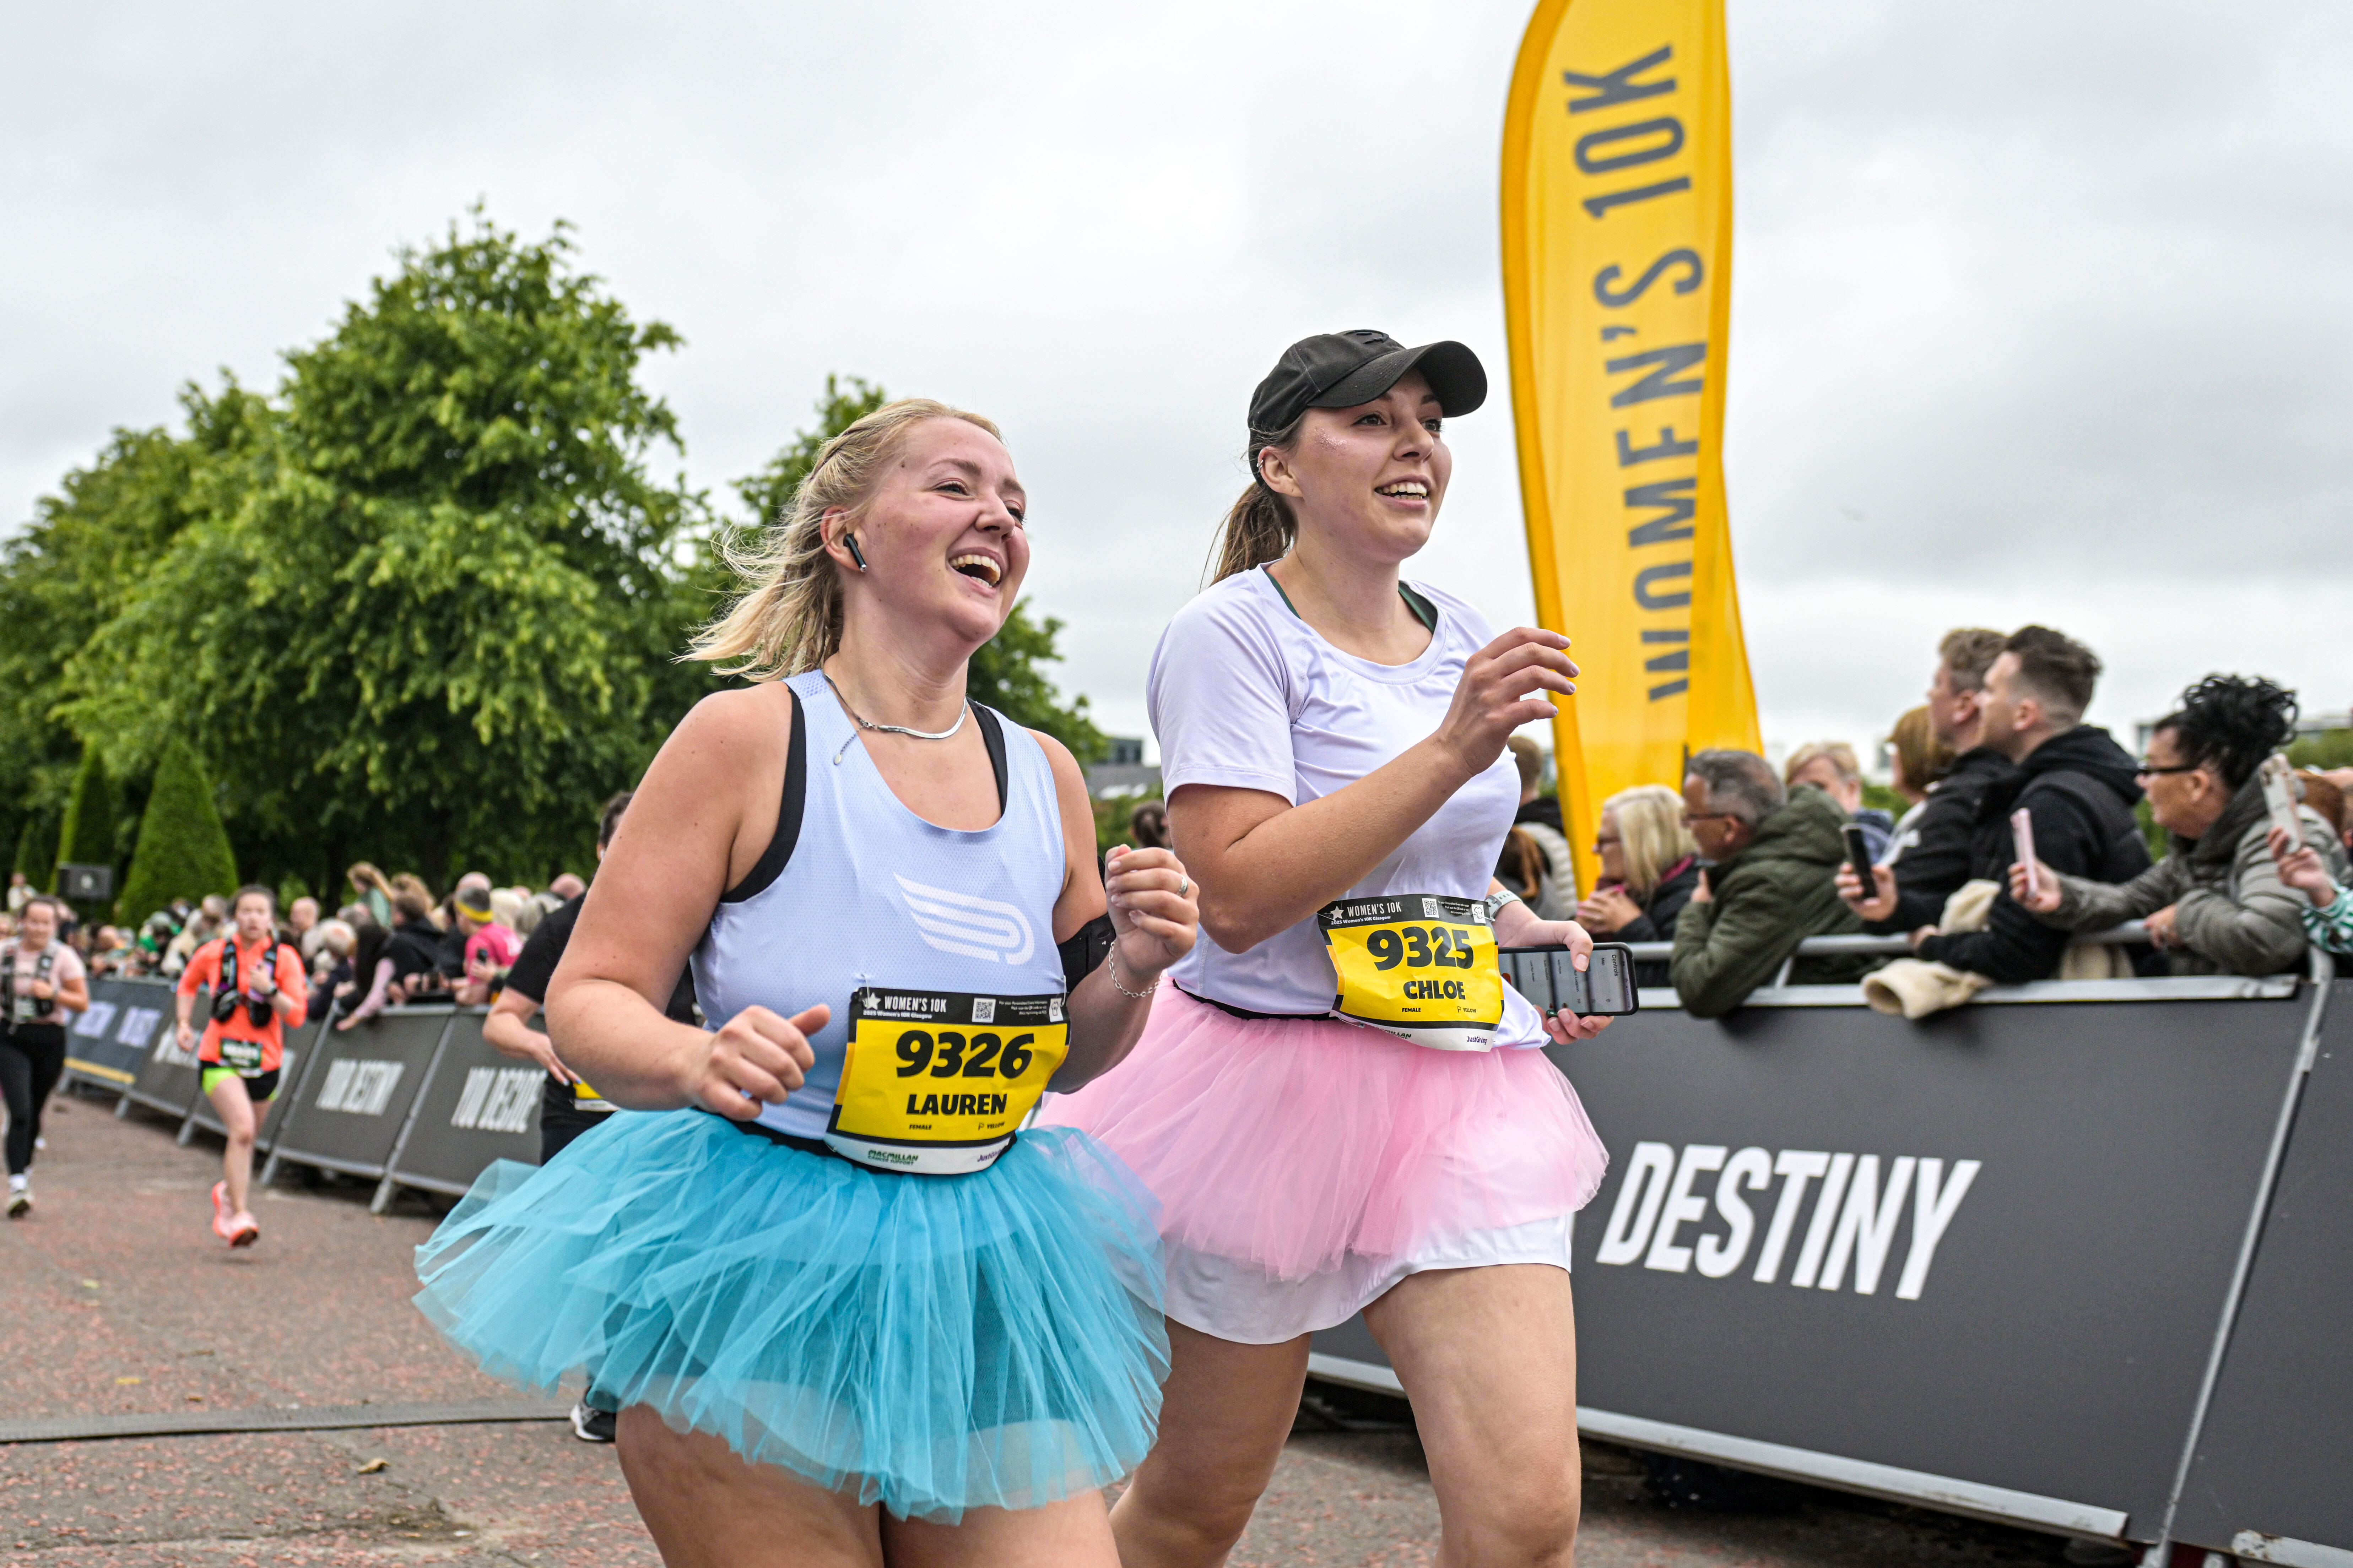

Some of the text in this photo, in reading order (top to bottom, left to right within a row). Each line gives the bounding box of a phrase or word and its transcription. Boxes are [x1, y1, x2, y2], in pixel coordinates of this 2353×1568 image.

[1564, 45, 1691, 219] 10K
[1347, 901, 1402, 917] WOMEN'S 10K
[1367, 926, 1474, 971] 9325
[1403, 980, 1466, 1000] CHLOE
[885, 995, 947, 1013] WOMEN'S 10K
[910, 1011, 933, 1020] Glasgow
[1373, 1027, 1412, 1038] MILLAN
[1466, 1036, 1487, 1045] JustGiving
[896, 1030, 1035, 1079] 9326
[906, 1093, 1008, 1116] LAUREN
[987, 1121, 1005, 1129] YELLOW
[868, 1150, 918, 1161] MACMILLAN
[1595, 1141, 1982, 1300] DESTINY
